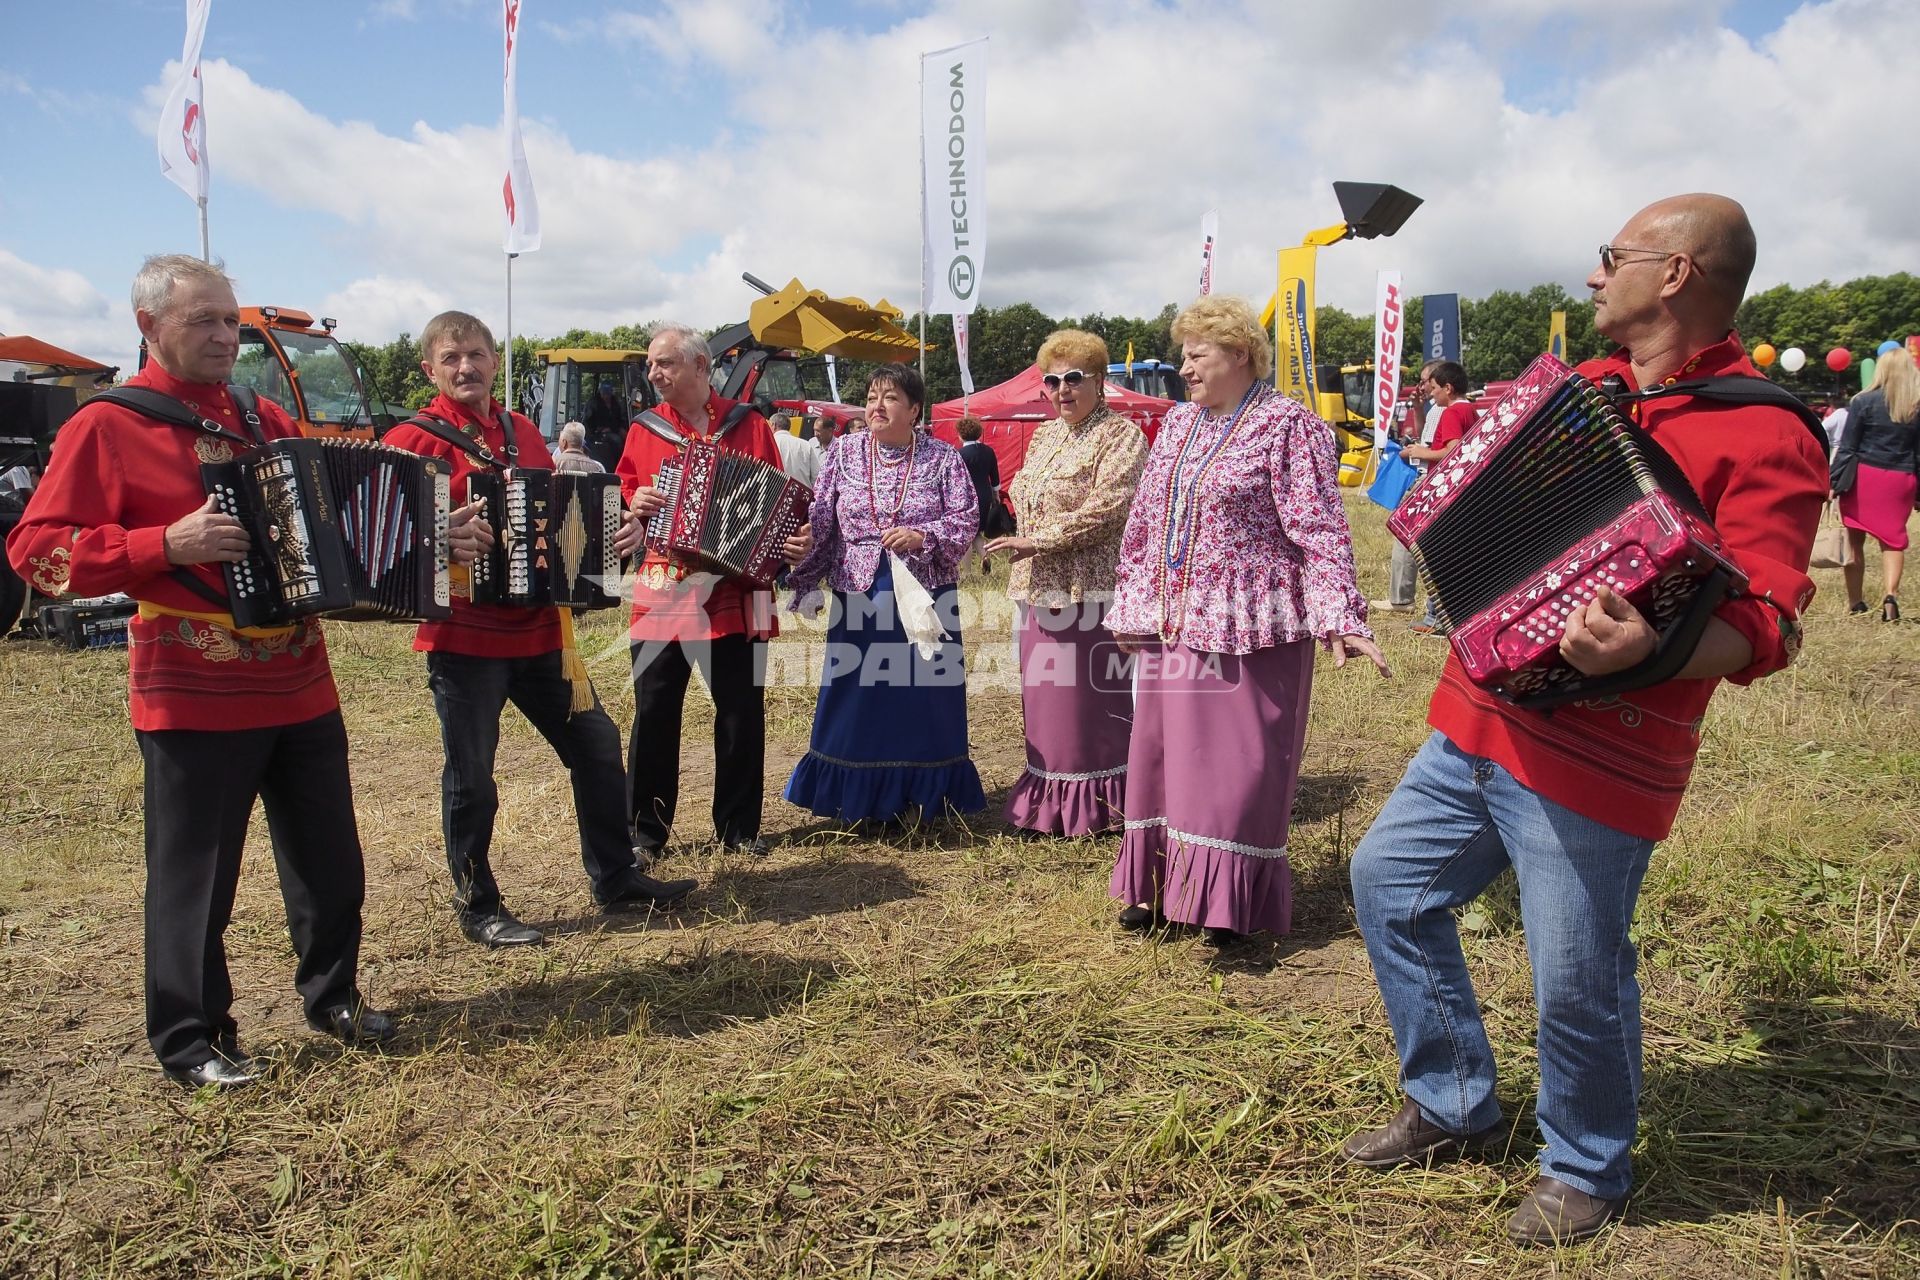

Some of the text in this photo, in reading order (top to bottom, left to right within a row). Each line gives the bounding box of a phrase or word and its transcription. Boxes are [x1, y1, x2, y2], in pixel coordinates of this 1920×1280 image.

[948, 62, 969, 250] TECHNODOM
[1290, 356, 1300, 386] NEW
[1379, 284, 1400, 432] HORSCH
